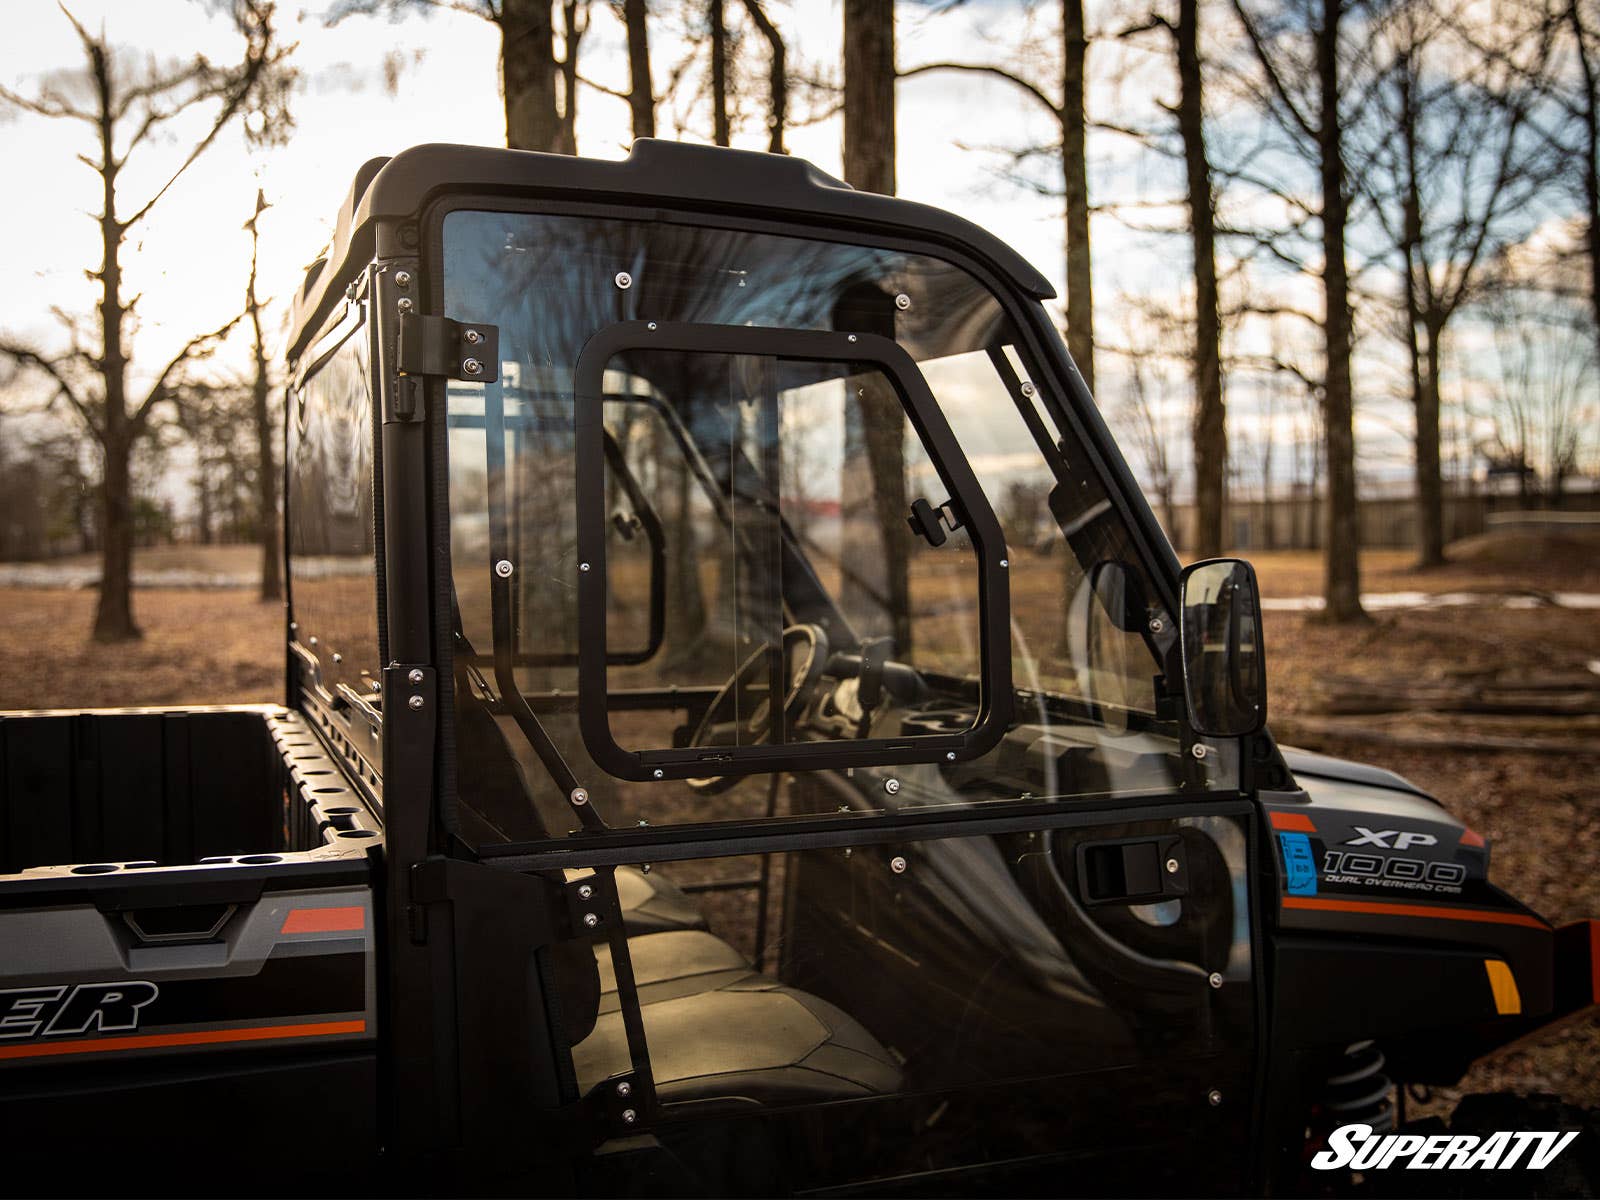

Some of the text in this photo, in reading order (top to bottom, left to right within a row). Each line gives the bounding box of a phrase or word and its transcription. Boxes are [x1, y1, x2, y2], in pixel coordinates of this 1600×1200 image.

[1345, 826, 1438, 850] XP
[1323, 850, 1466, 885] 1000
[1325, 874, 1463, 894] DUAL OVERHEAD CAM
